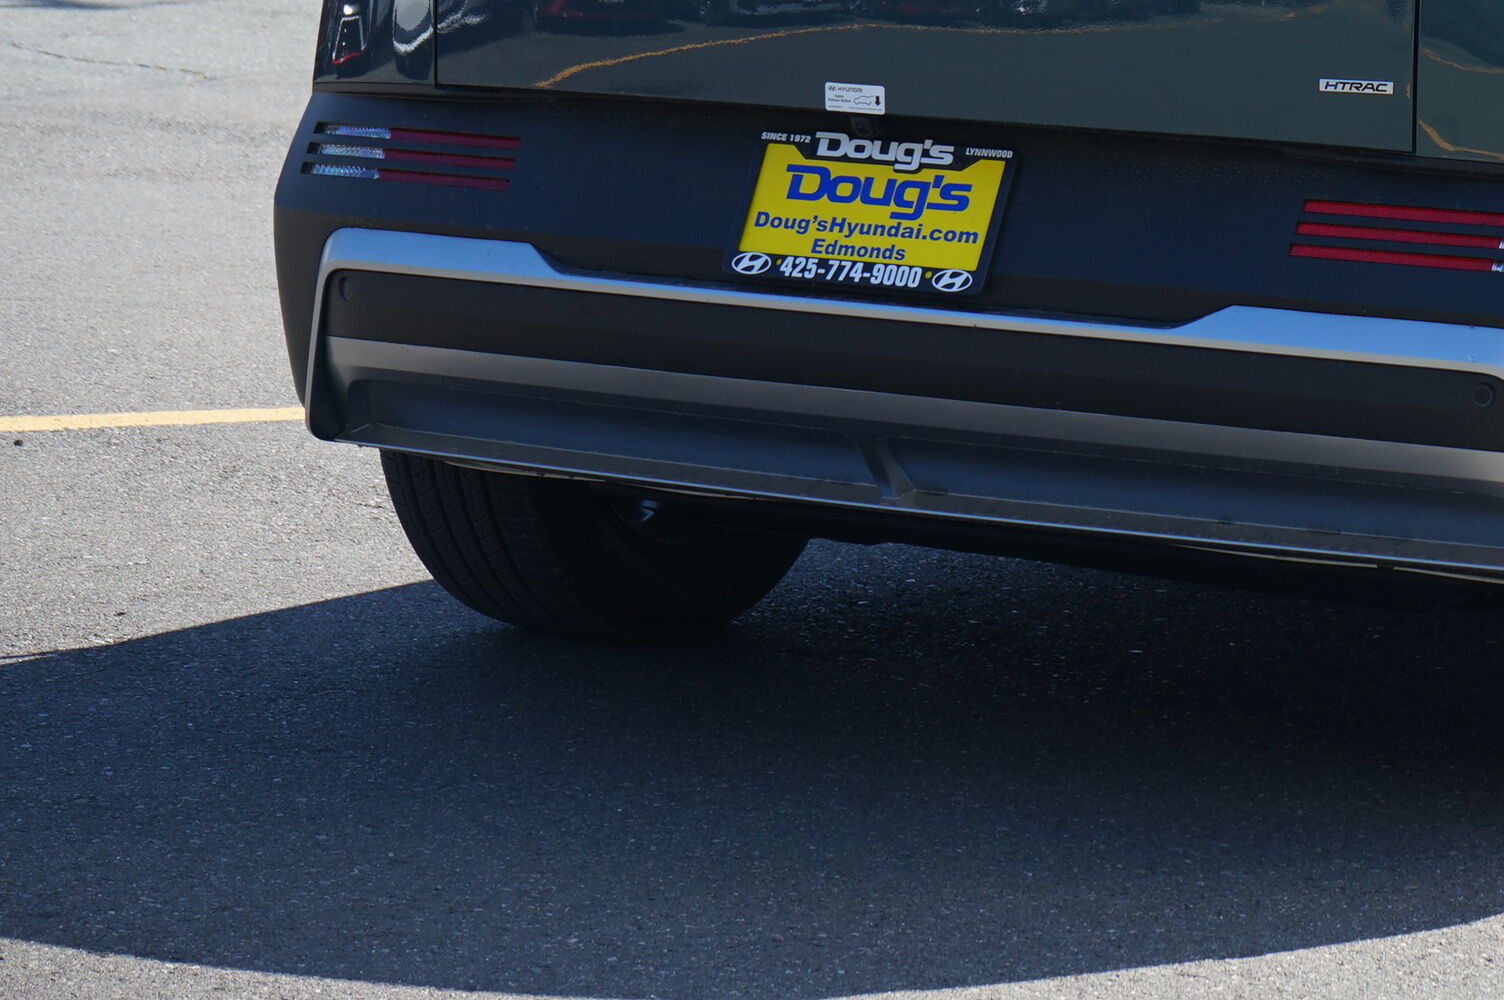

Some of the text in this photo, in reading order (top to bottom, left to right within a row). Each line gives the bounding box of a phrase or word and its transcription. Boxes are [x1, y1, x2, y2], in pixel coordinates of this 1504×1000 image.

[1324, 81, 1388, 92] HTRAC
[761, 131, 811, 143] SINCE 1972
[815, 131, 954, 171] Doug's
[965, 147, 1013, 159] LYNNWOOD
[786, 163, 972, 220] Doug's
[810, 238, 906, 261] Edmonds
[779, 256, 922, 288] 425-774-9000
